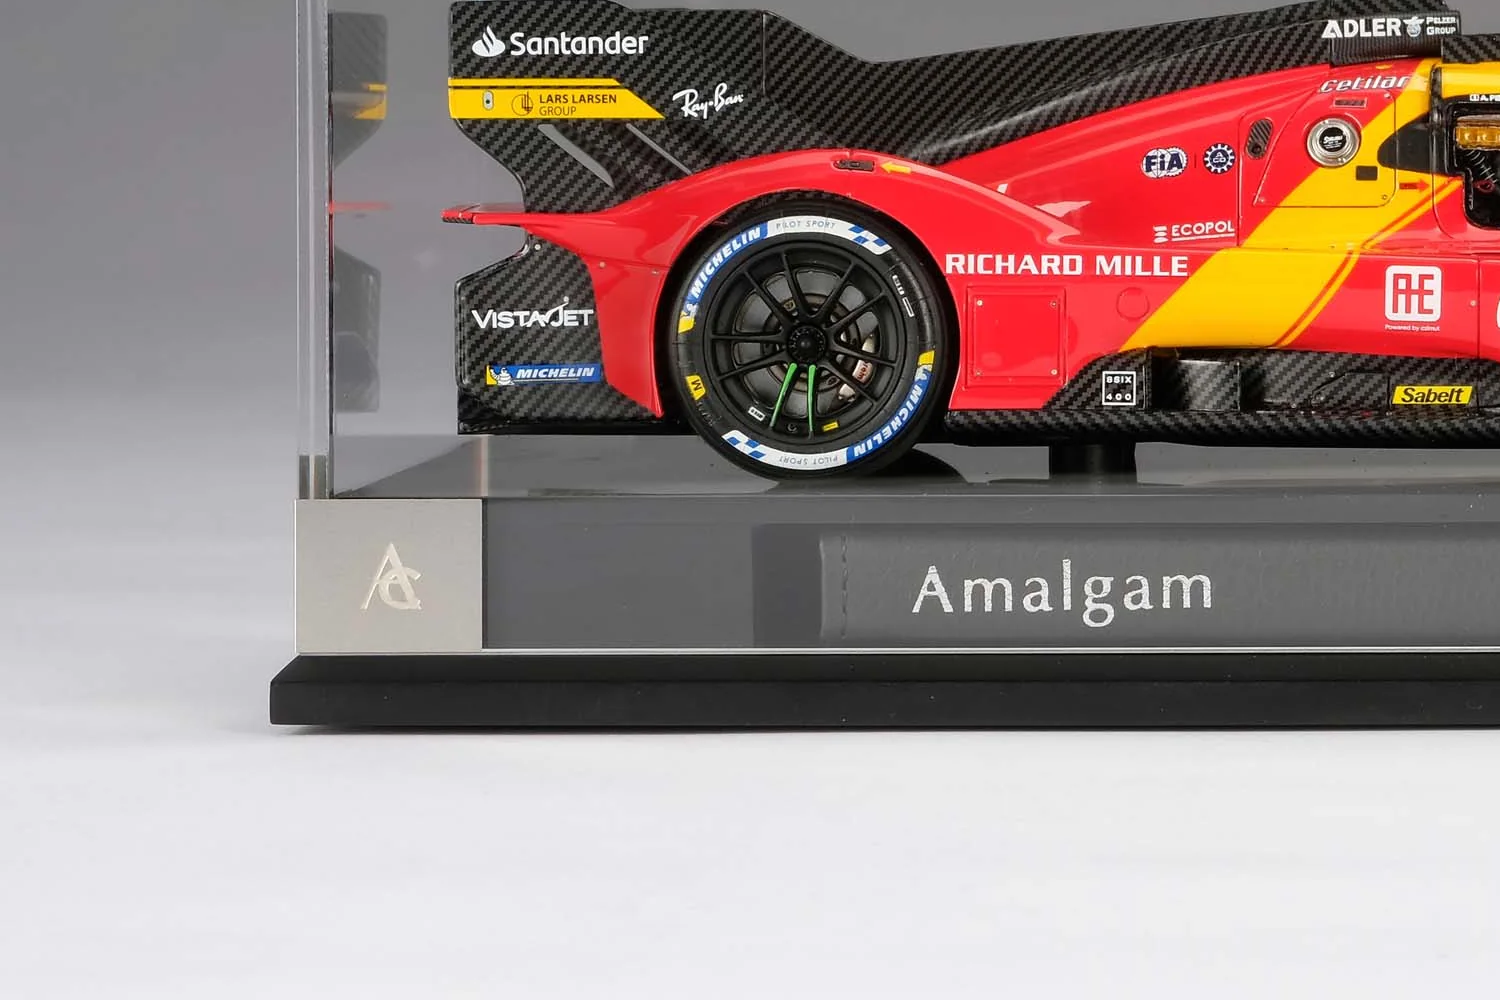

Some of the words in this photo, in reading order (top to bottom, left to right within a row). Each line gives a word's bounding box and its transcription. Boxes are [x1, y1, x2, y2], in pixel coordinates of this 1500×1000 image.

[1321, 17, 1402, 38] ADLER
[1426, 26, 1457, 35] GROUP
[510, 31, 649, 56] Santander
[539, 93, 569, 104] LARS
[571, 93, 617, 104] LARSEN
[539, 105, 577, 116] GROUP
[775, 221, 802, 230] PILOT
[805, 220, 836, 230] SPORT
[1171, 220, 1235, 237] ECOPOL
[690, 227, 761, 299] MICHELIN
[945, 253, 1083, 275] RICHARD
[1095, 255, 1189, 277] MILLE
[516, 367, 595, 379] MICHELIN
[1401, 387, 1465, 403] Sabelt
[853, 384, 923, 457] MICHELIN
[778, 456, 808, 465] SPORT
[812, 455, 838, 465] PILOT
[910, 558, 1215, 627] Amalgam
